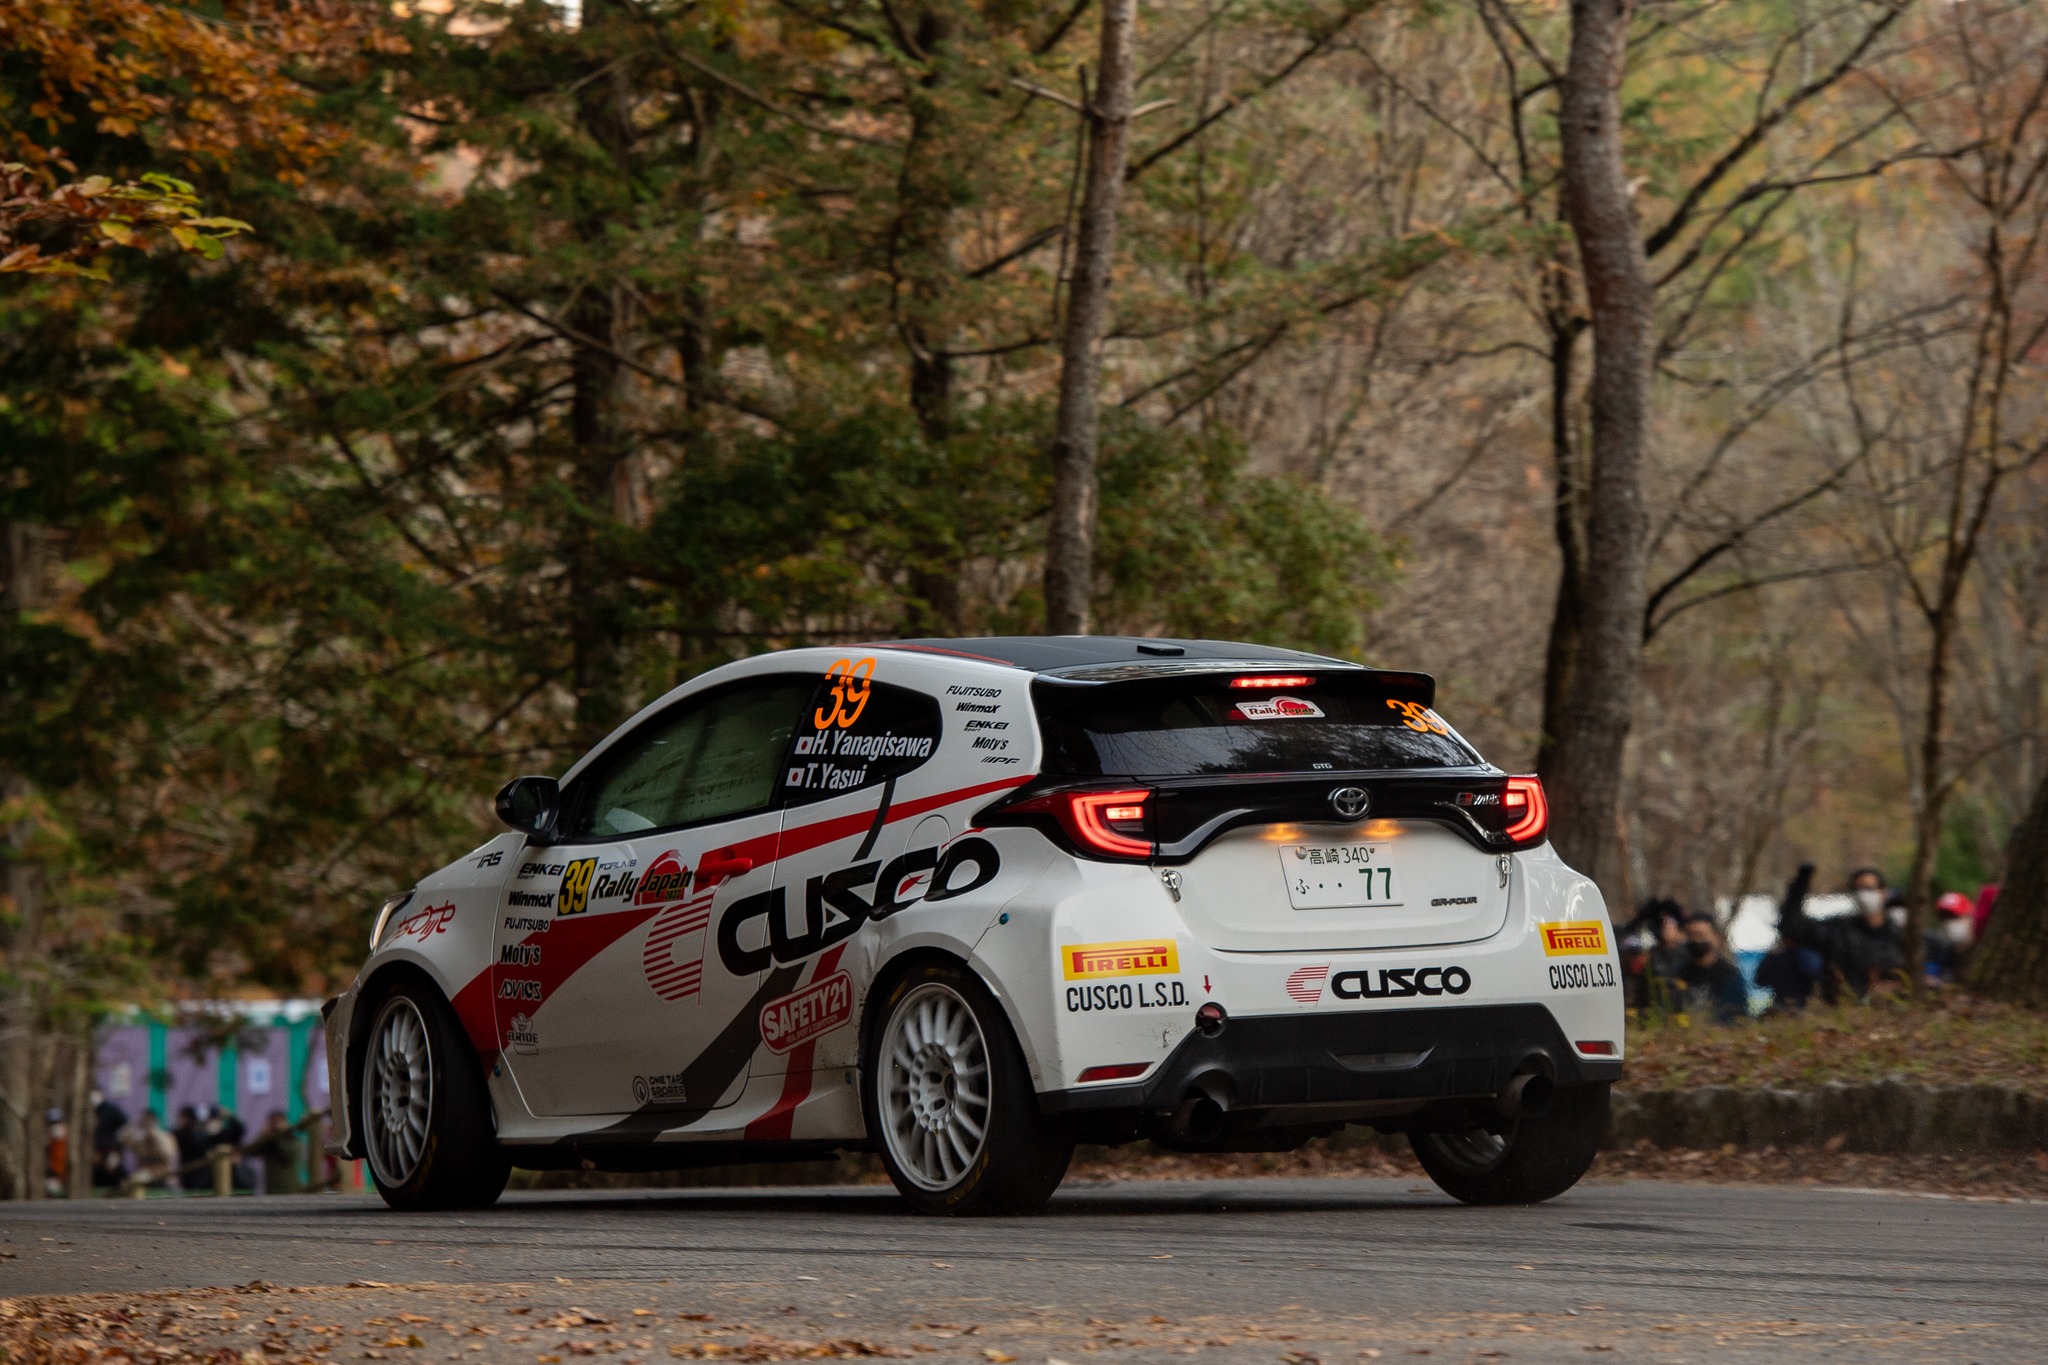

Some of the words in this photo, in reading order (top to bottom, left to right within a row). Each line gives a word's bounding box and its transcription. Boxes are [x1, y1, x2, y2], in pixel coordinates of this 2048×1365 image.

[814, 657, 876, 730] 39
[945, 685, 1002, 698] FUJITSUBO
[1249, 706, 1281, 716] Rally
[1280, 706, 1316, 716] Japan
[1386, 699, 1448, 736] 39
[965, 720, 1010, 730] ENKEI
[811, 730, 933, 762] H.Yanagisawa
[972, 736, 1009, 751] Moty's
[805, 763, 868, 790] T.Yasui
[519, 862, 566, 877] ENKEI
[559, 858, 595, 915] 39
[591, 870, 640, 904] Rally
[638, 868, 693, 898] Japan
[1295, 878, 1310, 895] ふ
[717, 836, 1001, 977] CUSCO
[504, 917, 549, 931] FUJITSUBO
[1546, 928, 1601, 949] PIRELLI
[500, 944, 540, 965] Moty's
[1072, 946, 1168, 973] PIRELLI
[1331, 966, 1471, 1000] CUSCO
[1549, 963, 1588, 990] CUSCO
[1589, 962, 1617, 988] L.S.D.
[1066, 983, 1132, 1012] CUSCO
[1138, 981, 1190, 1008] L.S.D.
[508, 1031, 539, 1043] BRIDE
[650, 1085, 685, 1096] SPORTS
